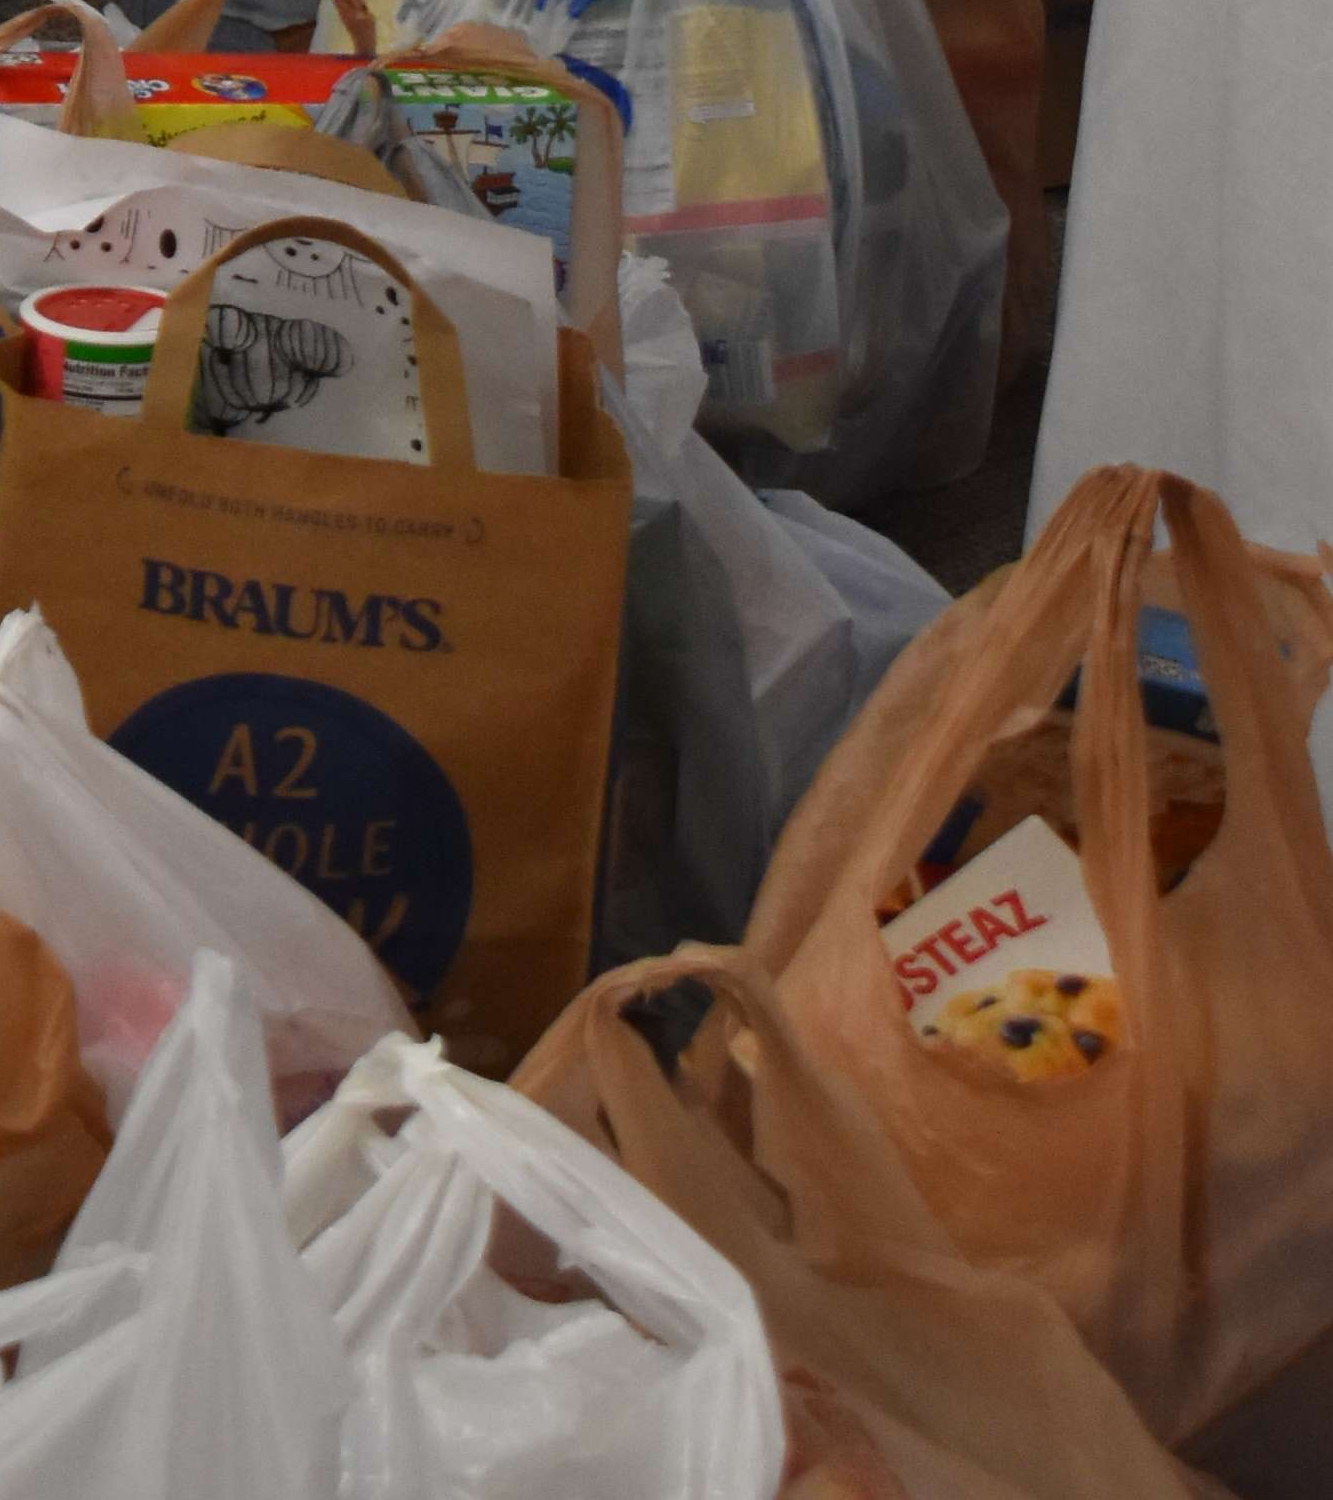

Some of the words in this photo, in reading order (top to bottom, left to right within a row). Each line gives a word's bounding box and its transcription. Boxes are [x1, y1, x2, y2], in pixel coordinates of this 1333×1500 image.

[392, 84, 550, 98] GIANT
[119, 365, 150, 381] Fact
[138, 556, 444, 653] BRAUM'S
[207, 721, 319, 798] A2
[243, 818, 397, 879] OLE
[895, 888, 1048, 1011] STEAZ
